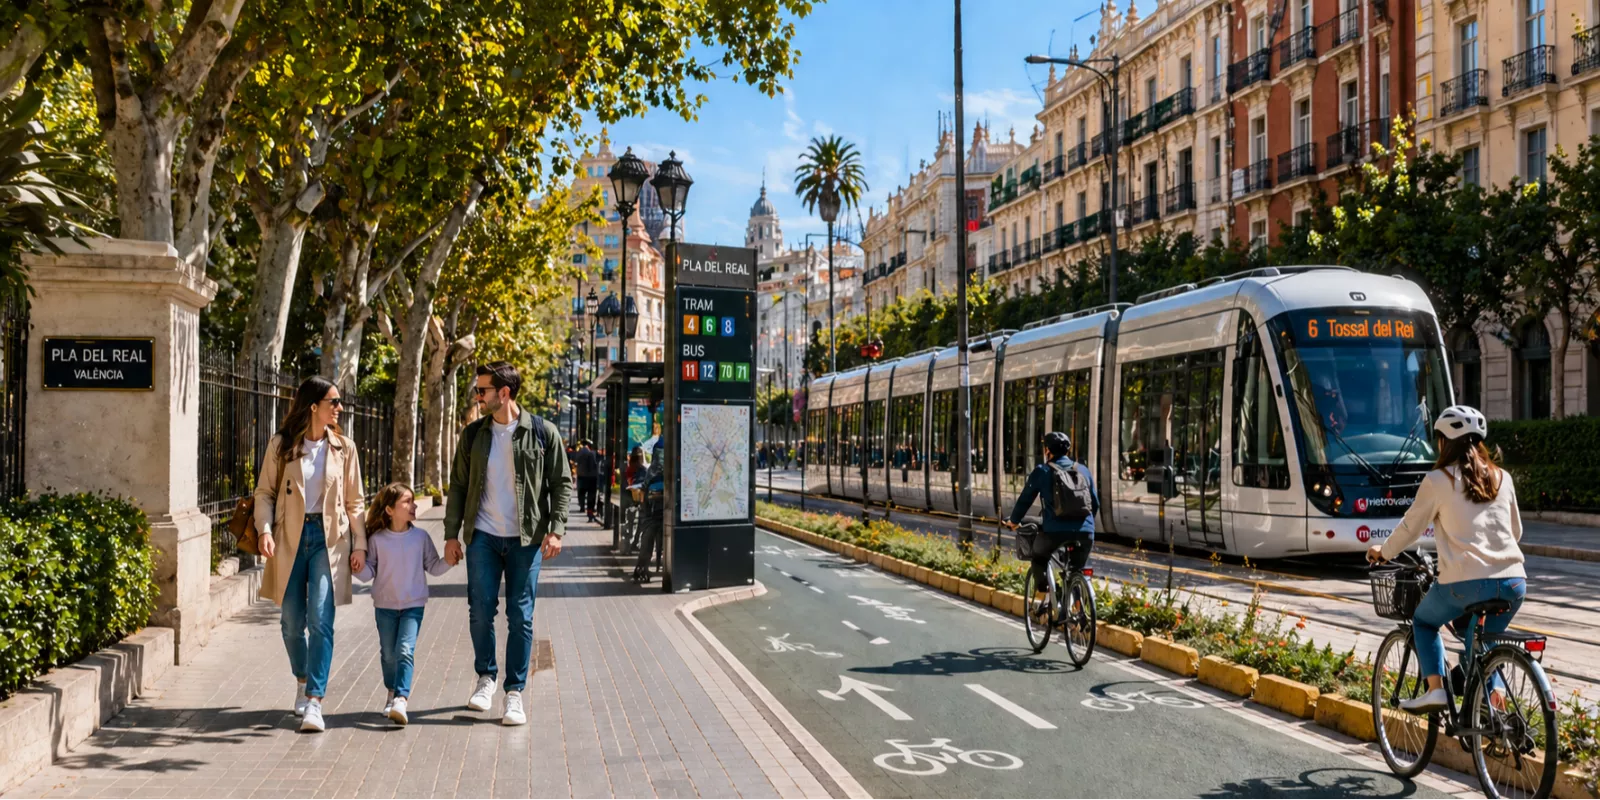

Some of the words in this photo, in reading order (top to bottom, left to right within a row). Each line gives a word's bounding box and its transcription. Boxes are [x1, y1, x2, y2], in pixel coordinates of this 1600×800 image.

[682, 259, 702, 272] PLA
[704, 261, 723, 273] DEL
[725, 263, 750, 275] REAL
[683, 297, 713, 311] TRAM
[687, 317, 695, 332] 4
[705, 318, 713, 333] 6
[725, 319, 732, 334] 8
[1308, 319, 1319, 338] 6
[1327, 319, 1369, 337] Tossal
[1373, 319, 1392, 337] del
[1395, 320, 1415, 338] Rei
[51, 348, 78, 362] PLA
[83, 348, 108, 362] DEL
[112, 349, 147, 363] REAL
[682, 344, 705, 357] BUS
[74, 367, 124, 380] VALÈNCIA
[685, 364, 695, 377] 11
[702, 364, 713, 378] 12
[721, 364, 732, 379] 70
[737, 365, 747, 379] 71
